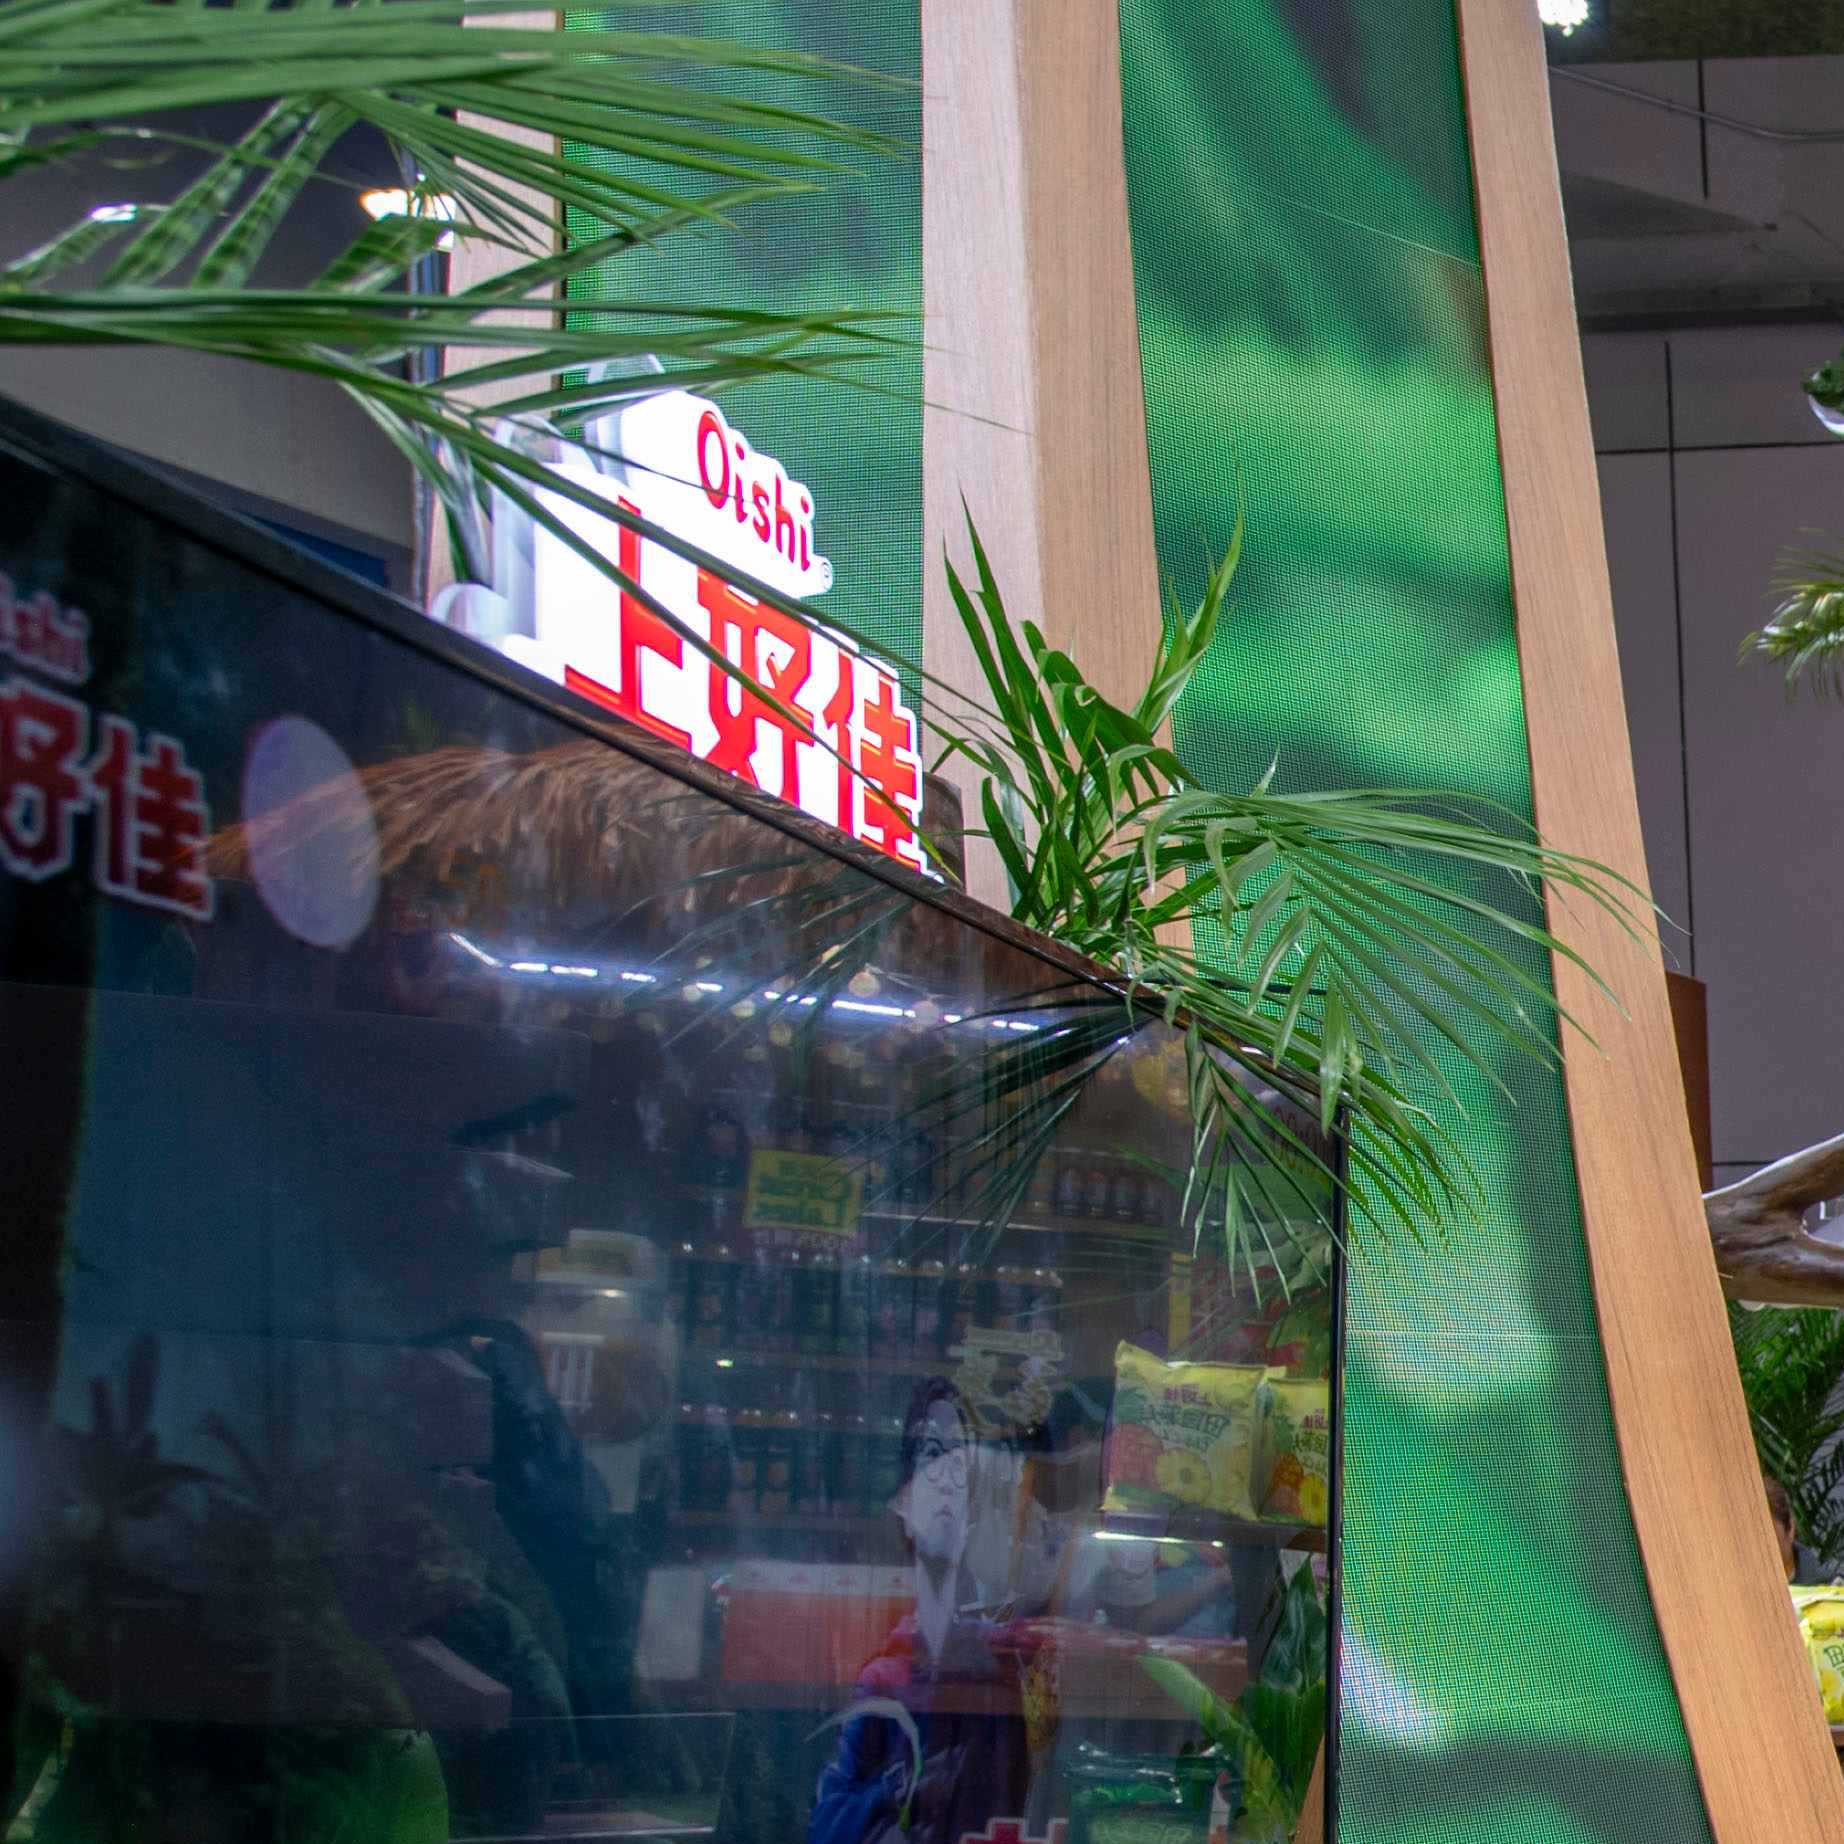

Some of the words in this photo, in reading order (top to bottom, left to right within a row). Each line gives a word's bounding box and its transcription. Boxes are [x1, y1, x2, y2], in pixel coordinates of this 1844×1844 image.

[697, 410, 811, 571] Oishi
[565, 495, 922, 872] 上好佳
